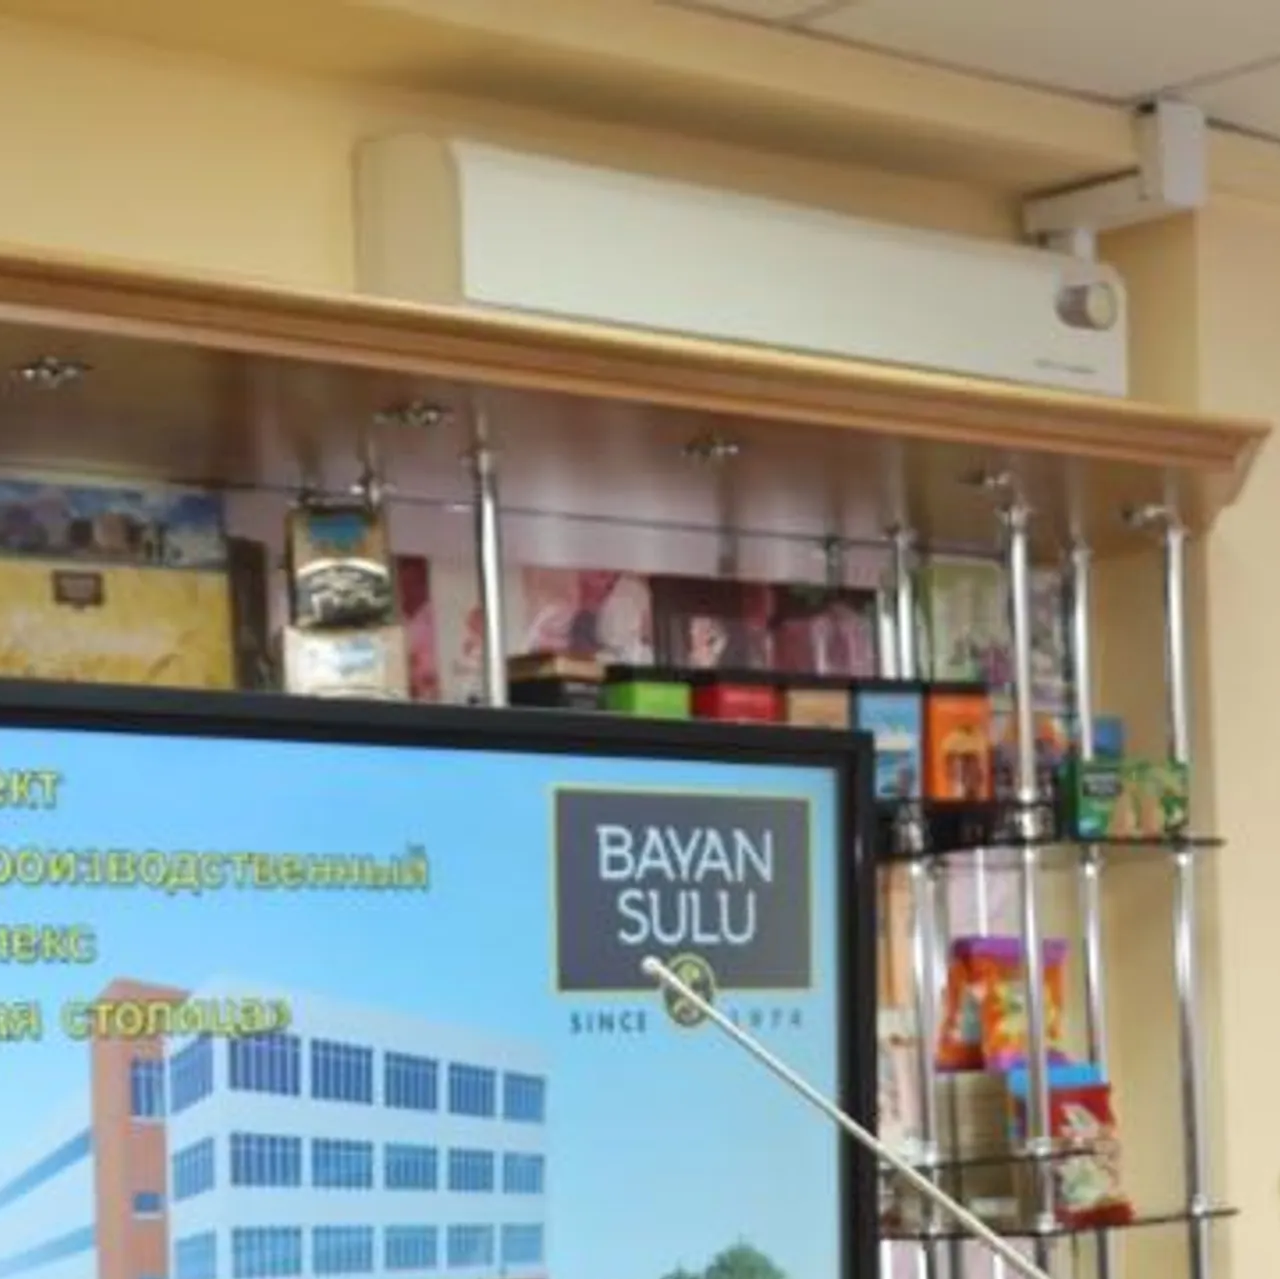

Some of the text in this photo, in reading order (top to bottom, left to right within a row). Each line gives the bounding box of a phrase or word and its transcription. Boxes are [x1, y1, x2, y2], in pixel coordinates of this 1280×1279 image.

[596, 824, 773, 883] BAYAN
[617, 888, 757, 945] SULU
[569, 1008, 647, 1036] SINCE
